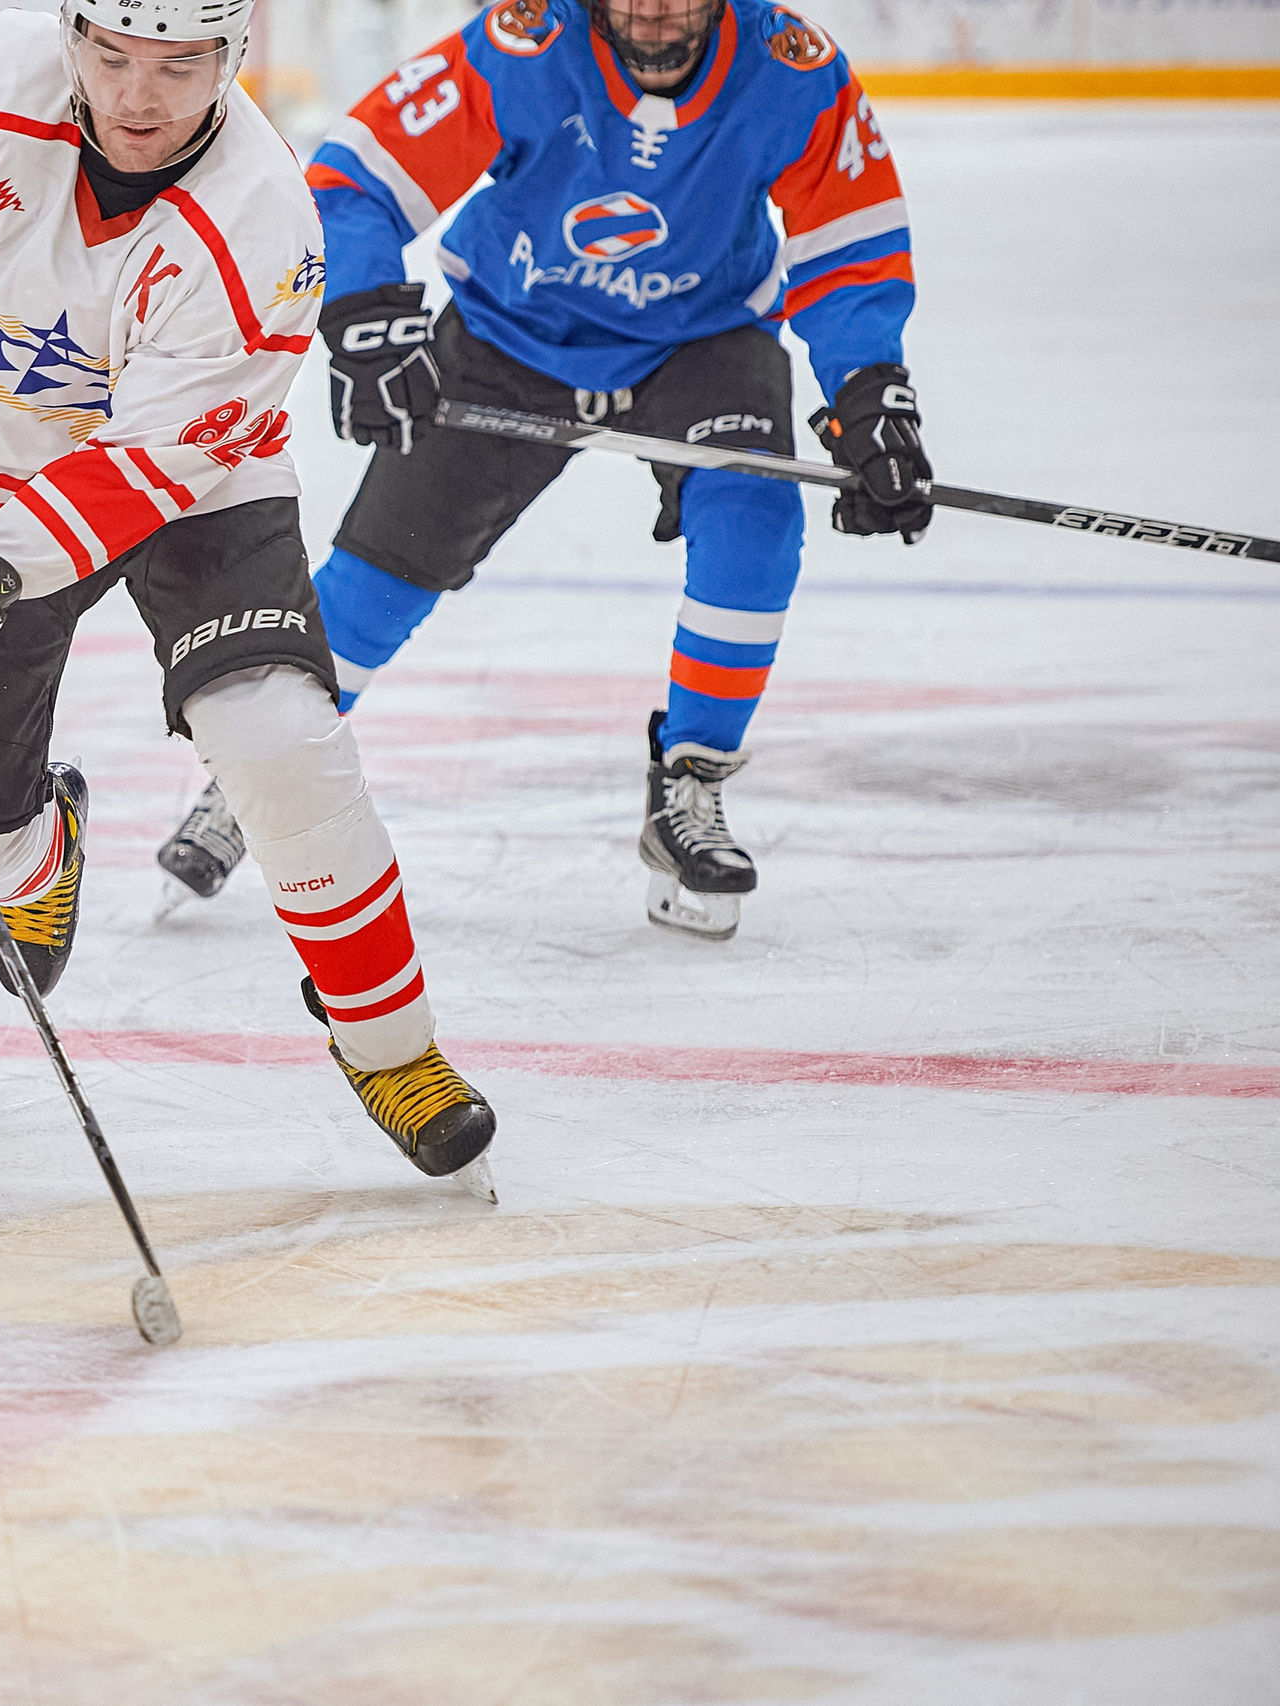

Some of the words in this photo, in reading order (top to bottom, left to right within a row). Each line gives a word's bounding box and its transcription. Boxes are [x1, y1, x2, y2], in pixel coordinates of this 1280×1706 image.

[385, 54, 461, 137] 43
[836, 90, 890, 182] 43
[341, 315, 436, 352] CC
[178, 396, 273, 472] 82
[686, 413, 773, 444] CCM
[170, 608, 308, 670] BAUER
[278, 873, 335, 893] LUTCH
